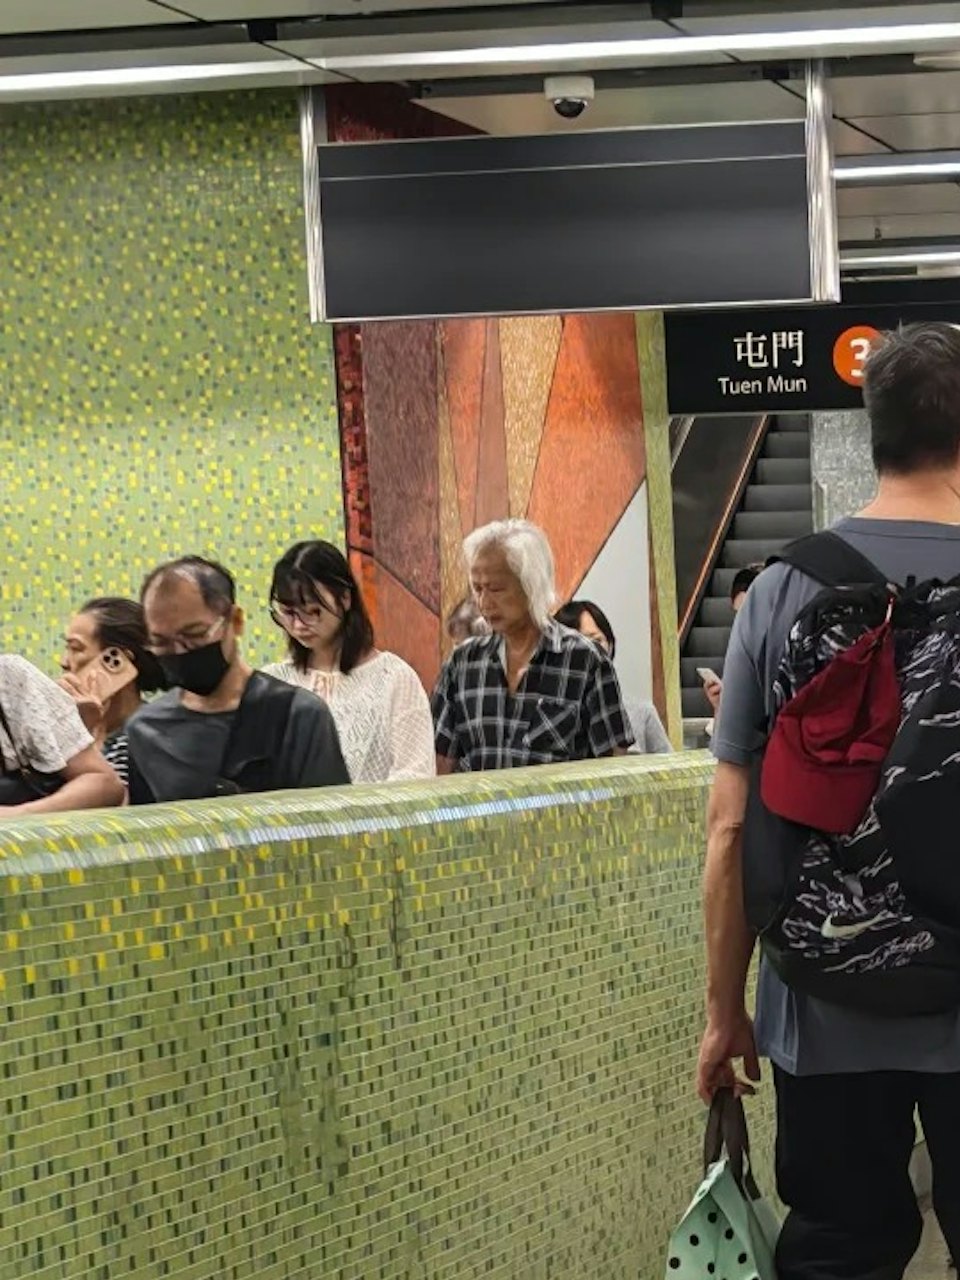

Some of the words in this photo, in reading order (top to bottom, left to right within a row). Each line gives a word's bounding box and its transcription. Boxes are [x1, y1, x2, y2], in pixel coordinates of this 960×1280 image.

[733, 330, 804, 369] 屯門
[717, 376, 762, 396] Tuen
[766, 374, 807, 393] Mun
